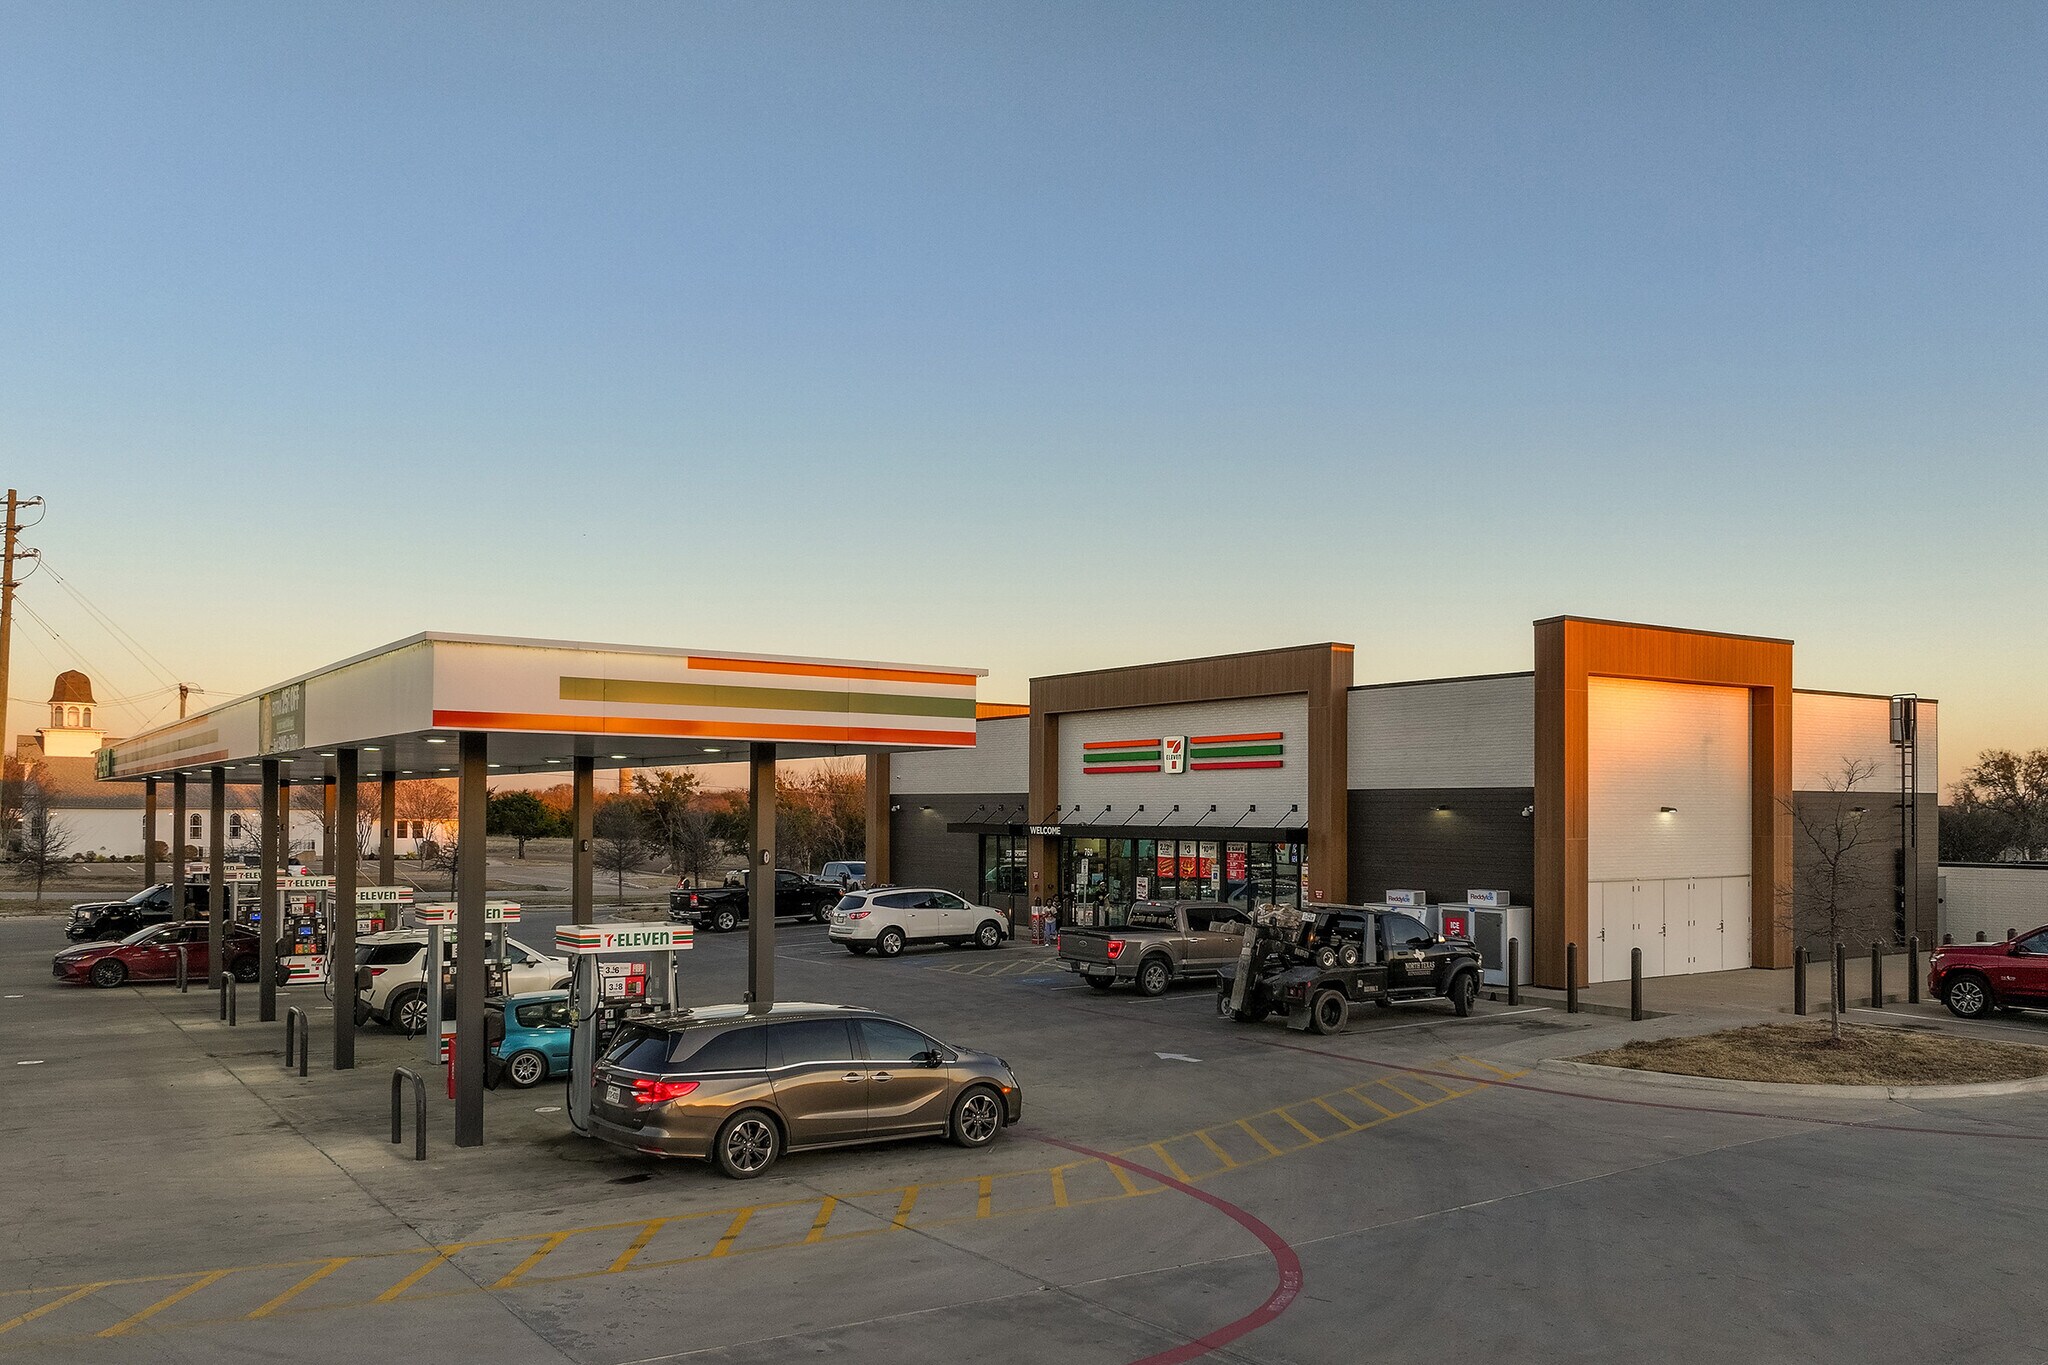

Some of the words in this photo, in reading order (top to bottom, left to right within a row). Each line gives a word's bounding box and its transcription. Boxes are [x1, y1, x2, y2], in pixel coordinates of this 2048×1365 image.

[1029, 826, 1061, 835] WELCOME
[1450, 921, 1460, 929] ICE
[1421, 961, 1435, 969] TEXAS
